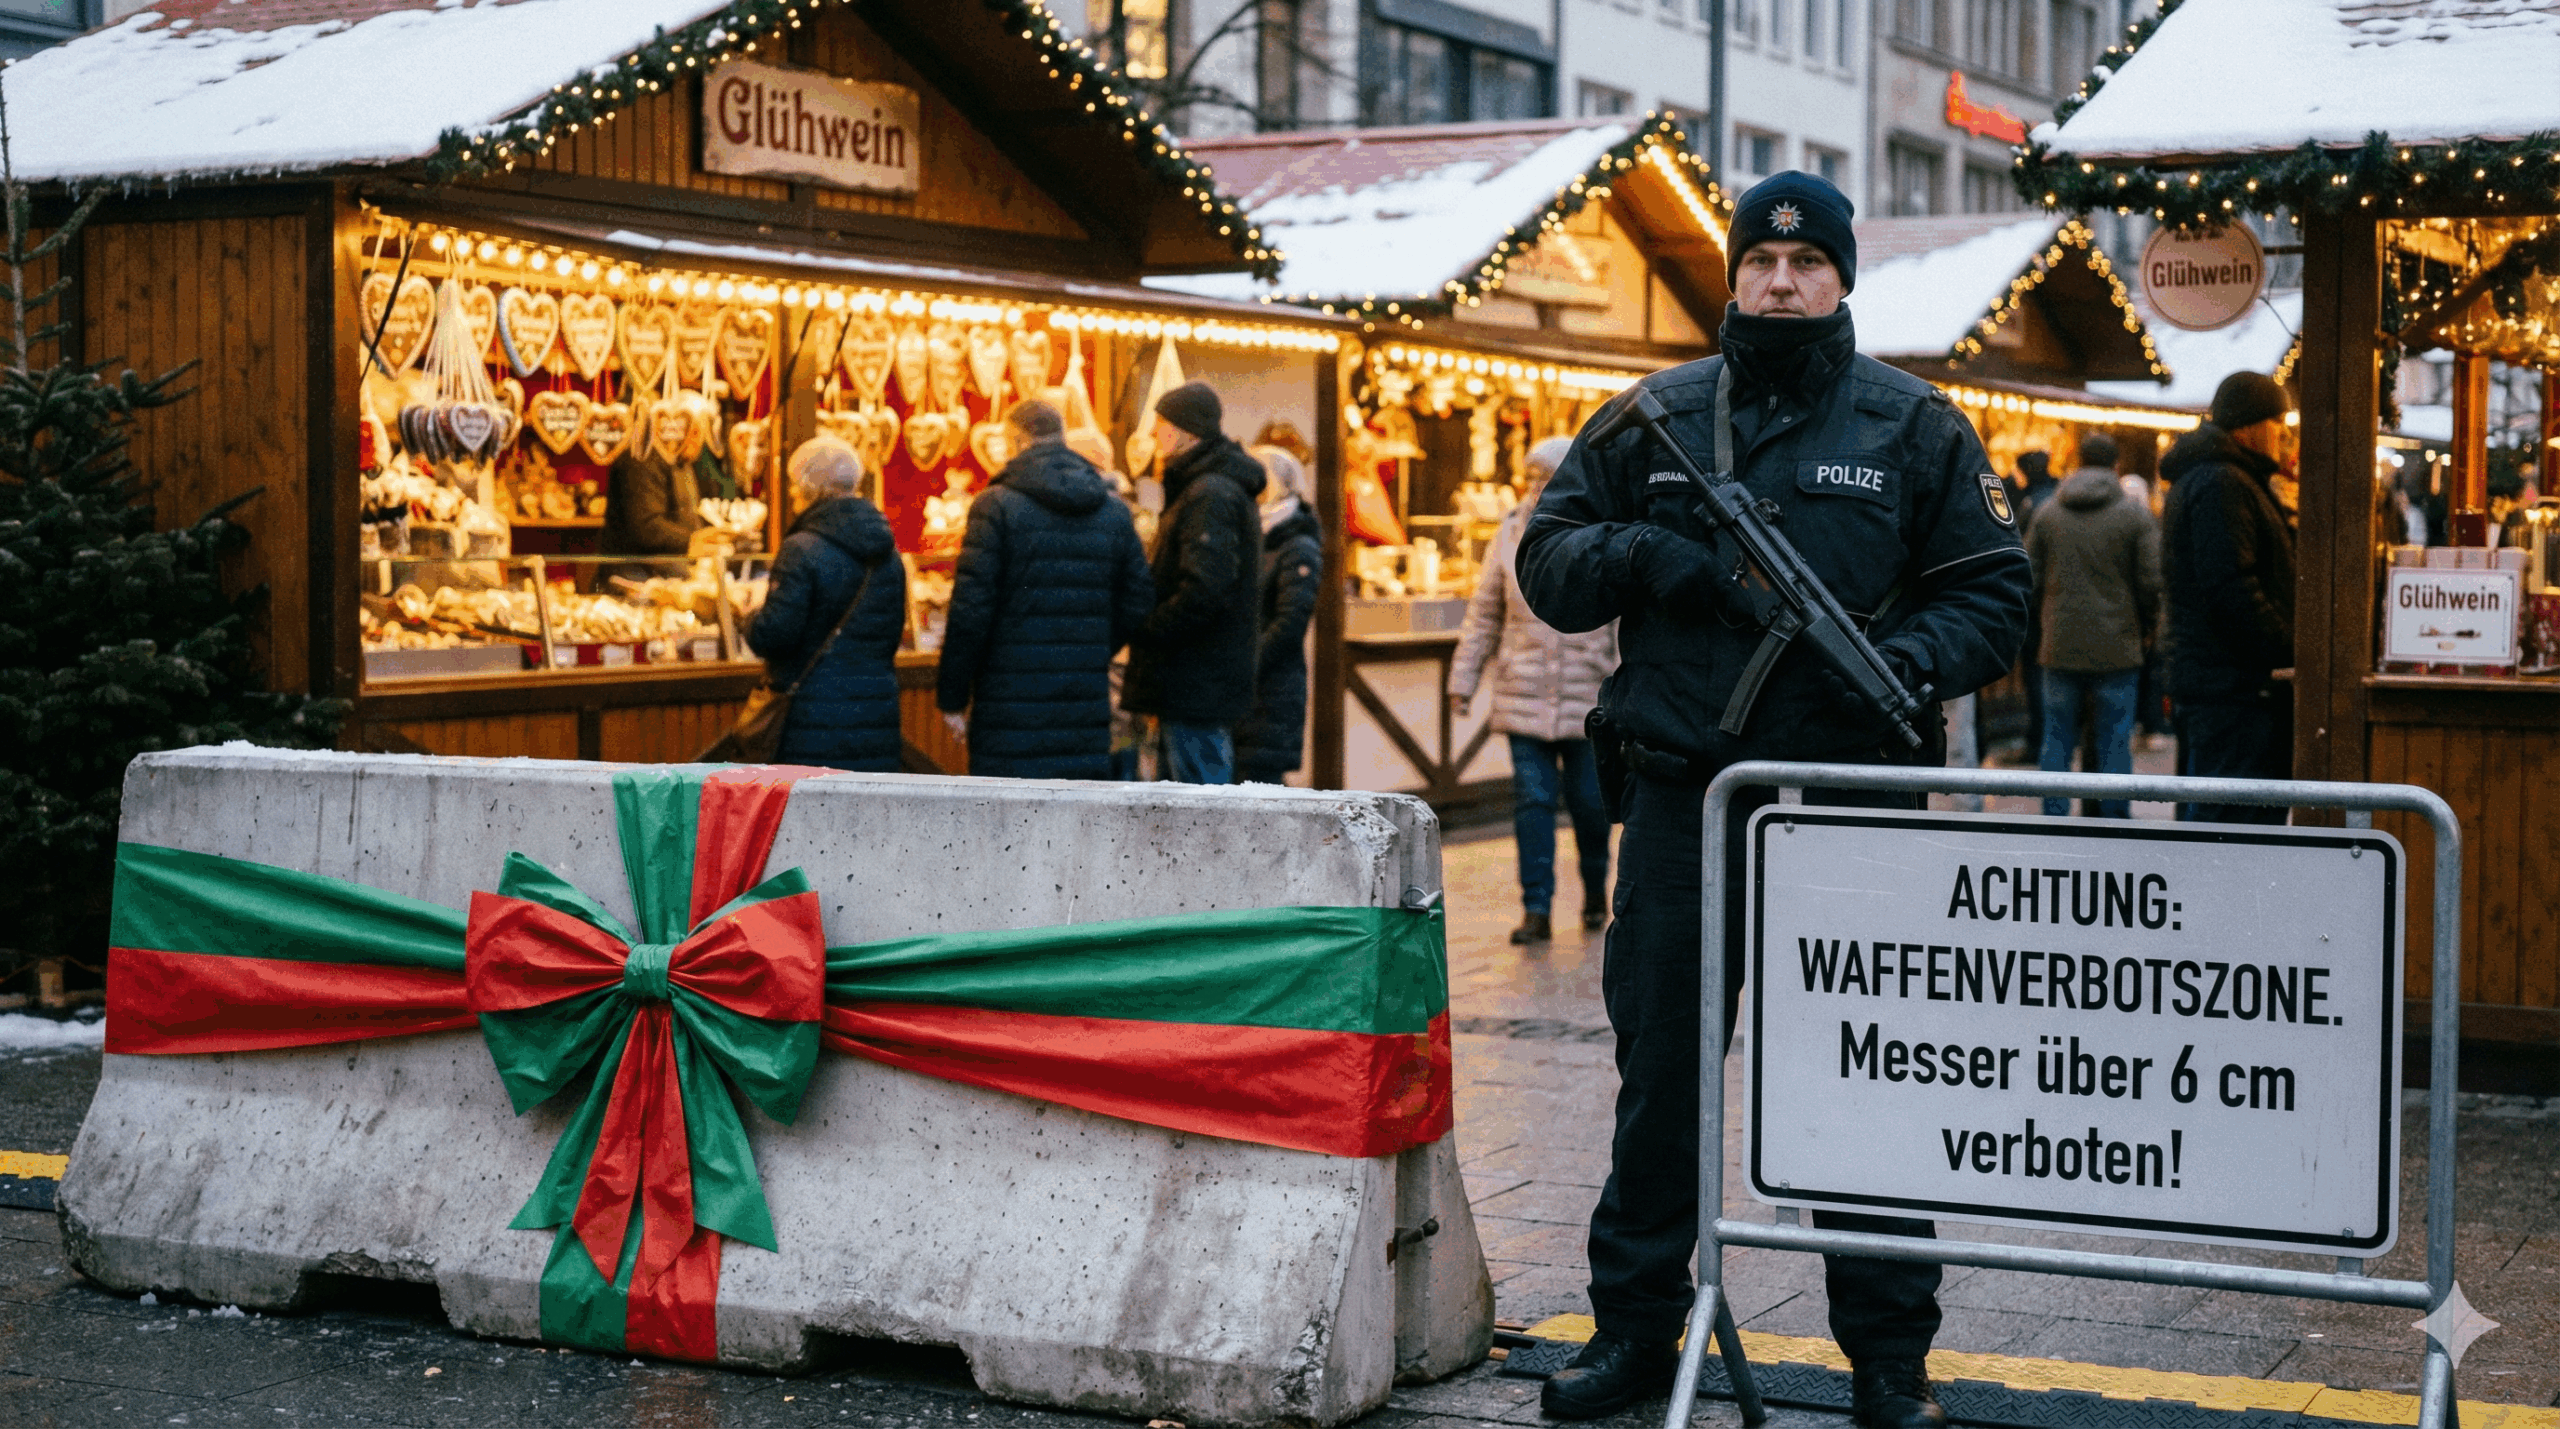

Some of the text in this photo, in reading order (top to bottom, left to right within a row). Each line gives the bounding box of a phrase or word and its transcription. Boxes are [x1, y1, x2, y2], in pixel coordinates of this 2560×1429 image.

[718, 76, 905, 168] Glühwein
[2152, 258, 2252, 288] Glühwein
[1817, 465, 1884, 492] POLIZE
[2400, 583, 2499, 611] Glühwein
[1947, 865, 2182, 931] ACHTUNG:
[1798, 937, 2343, 1027] WAFFENVERBOTSZONE.
[1840, 1020, 2295, 1112] Messer über 6 cm
[1941, 1118, 2183, 1189] verboten!
